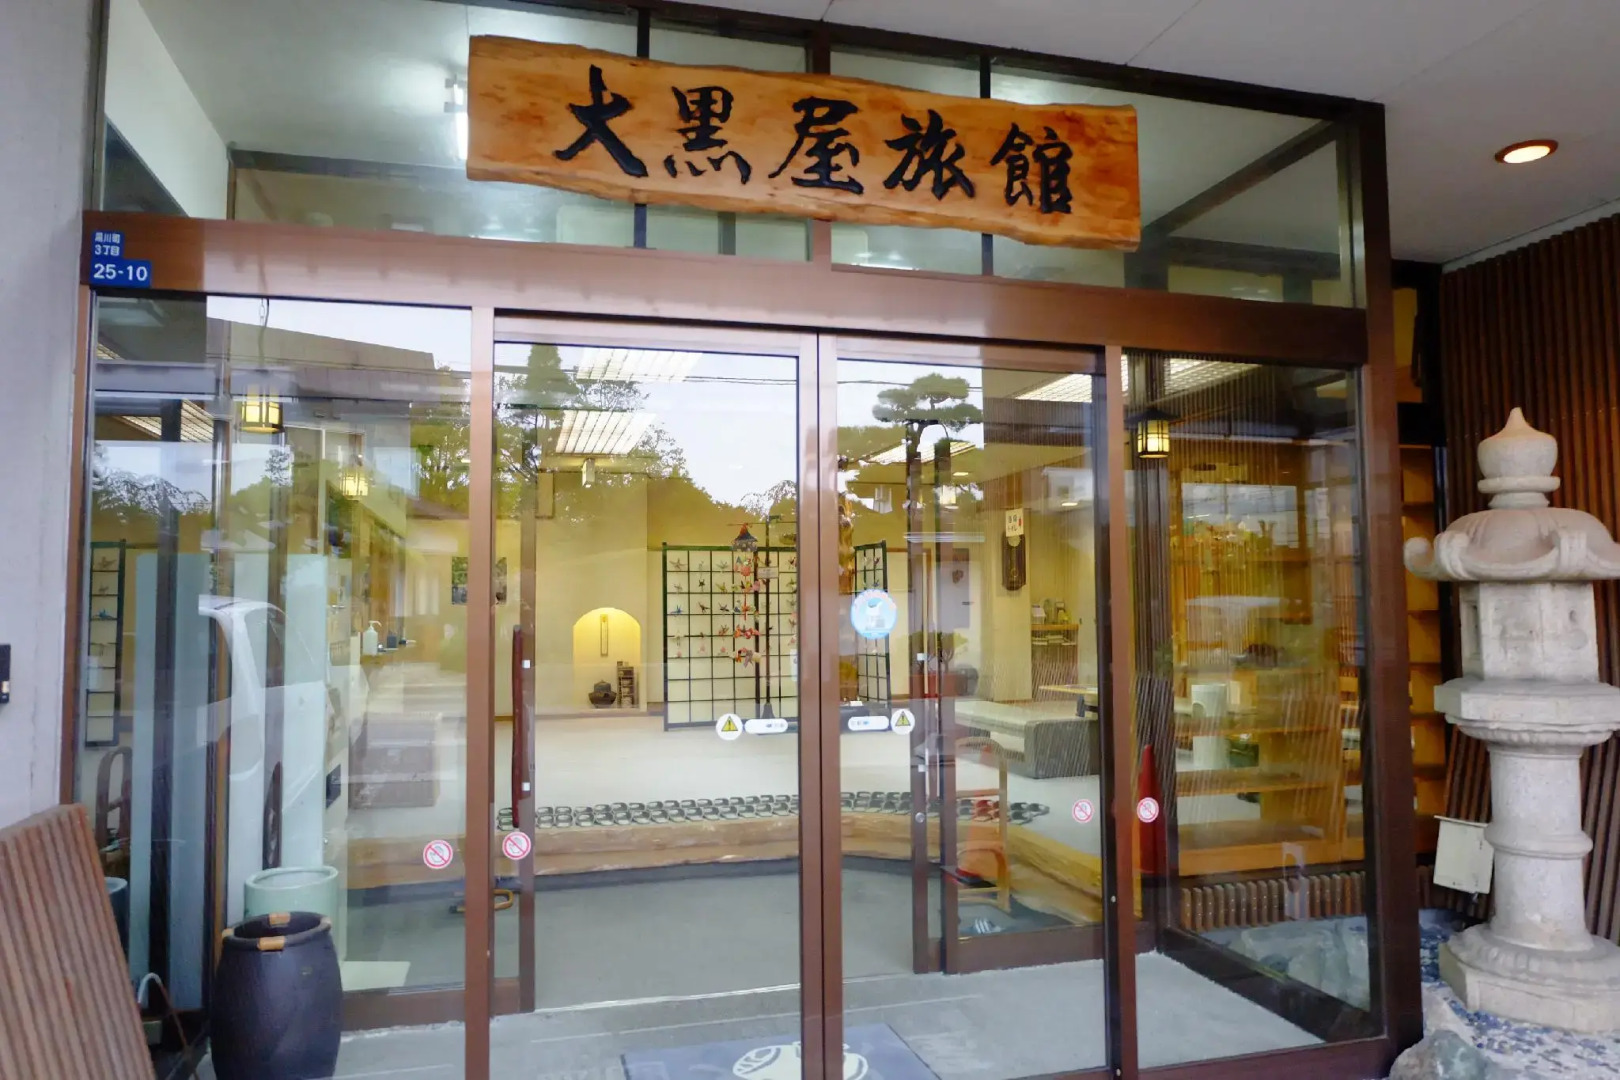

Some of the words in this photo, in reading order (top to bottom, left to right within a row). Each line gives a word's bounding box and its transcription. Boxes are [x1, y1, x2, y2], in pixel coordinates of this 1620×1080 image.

[553, 64, 1074, 215] 大黒屋旅館
[94, 244, 120, 256] 3丁目
[93, 263, 148, 281] 25-10
